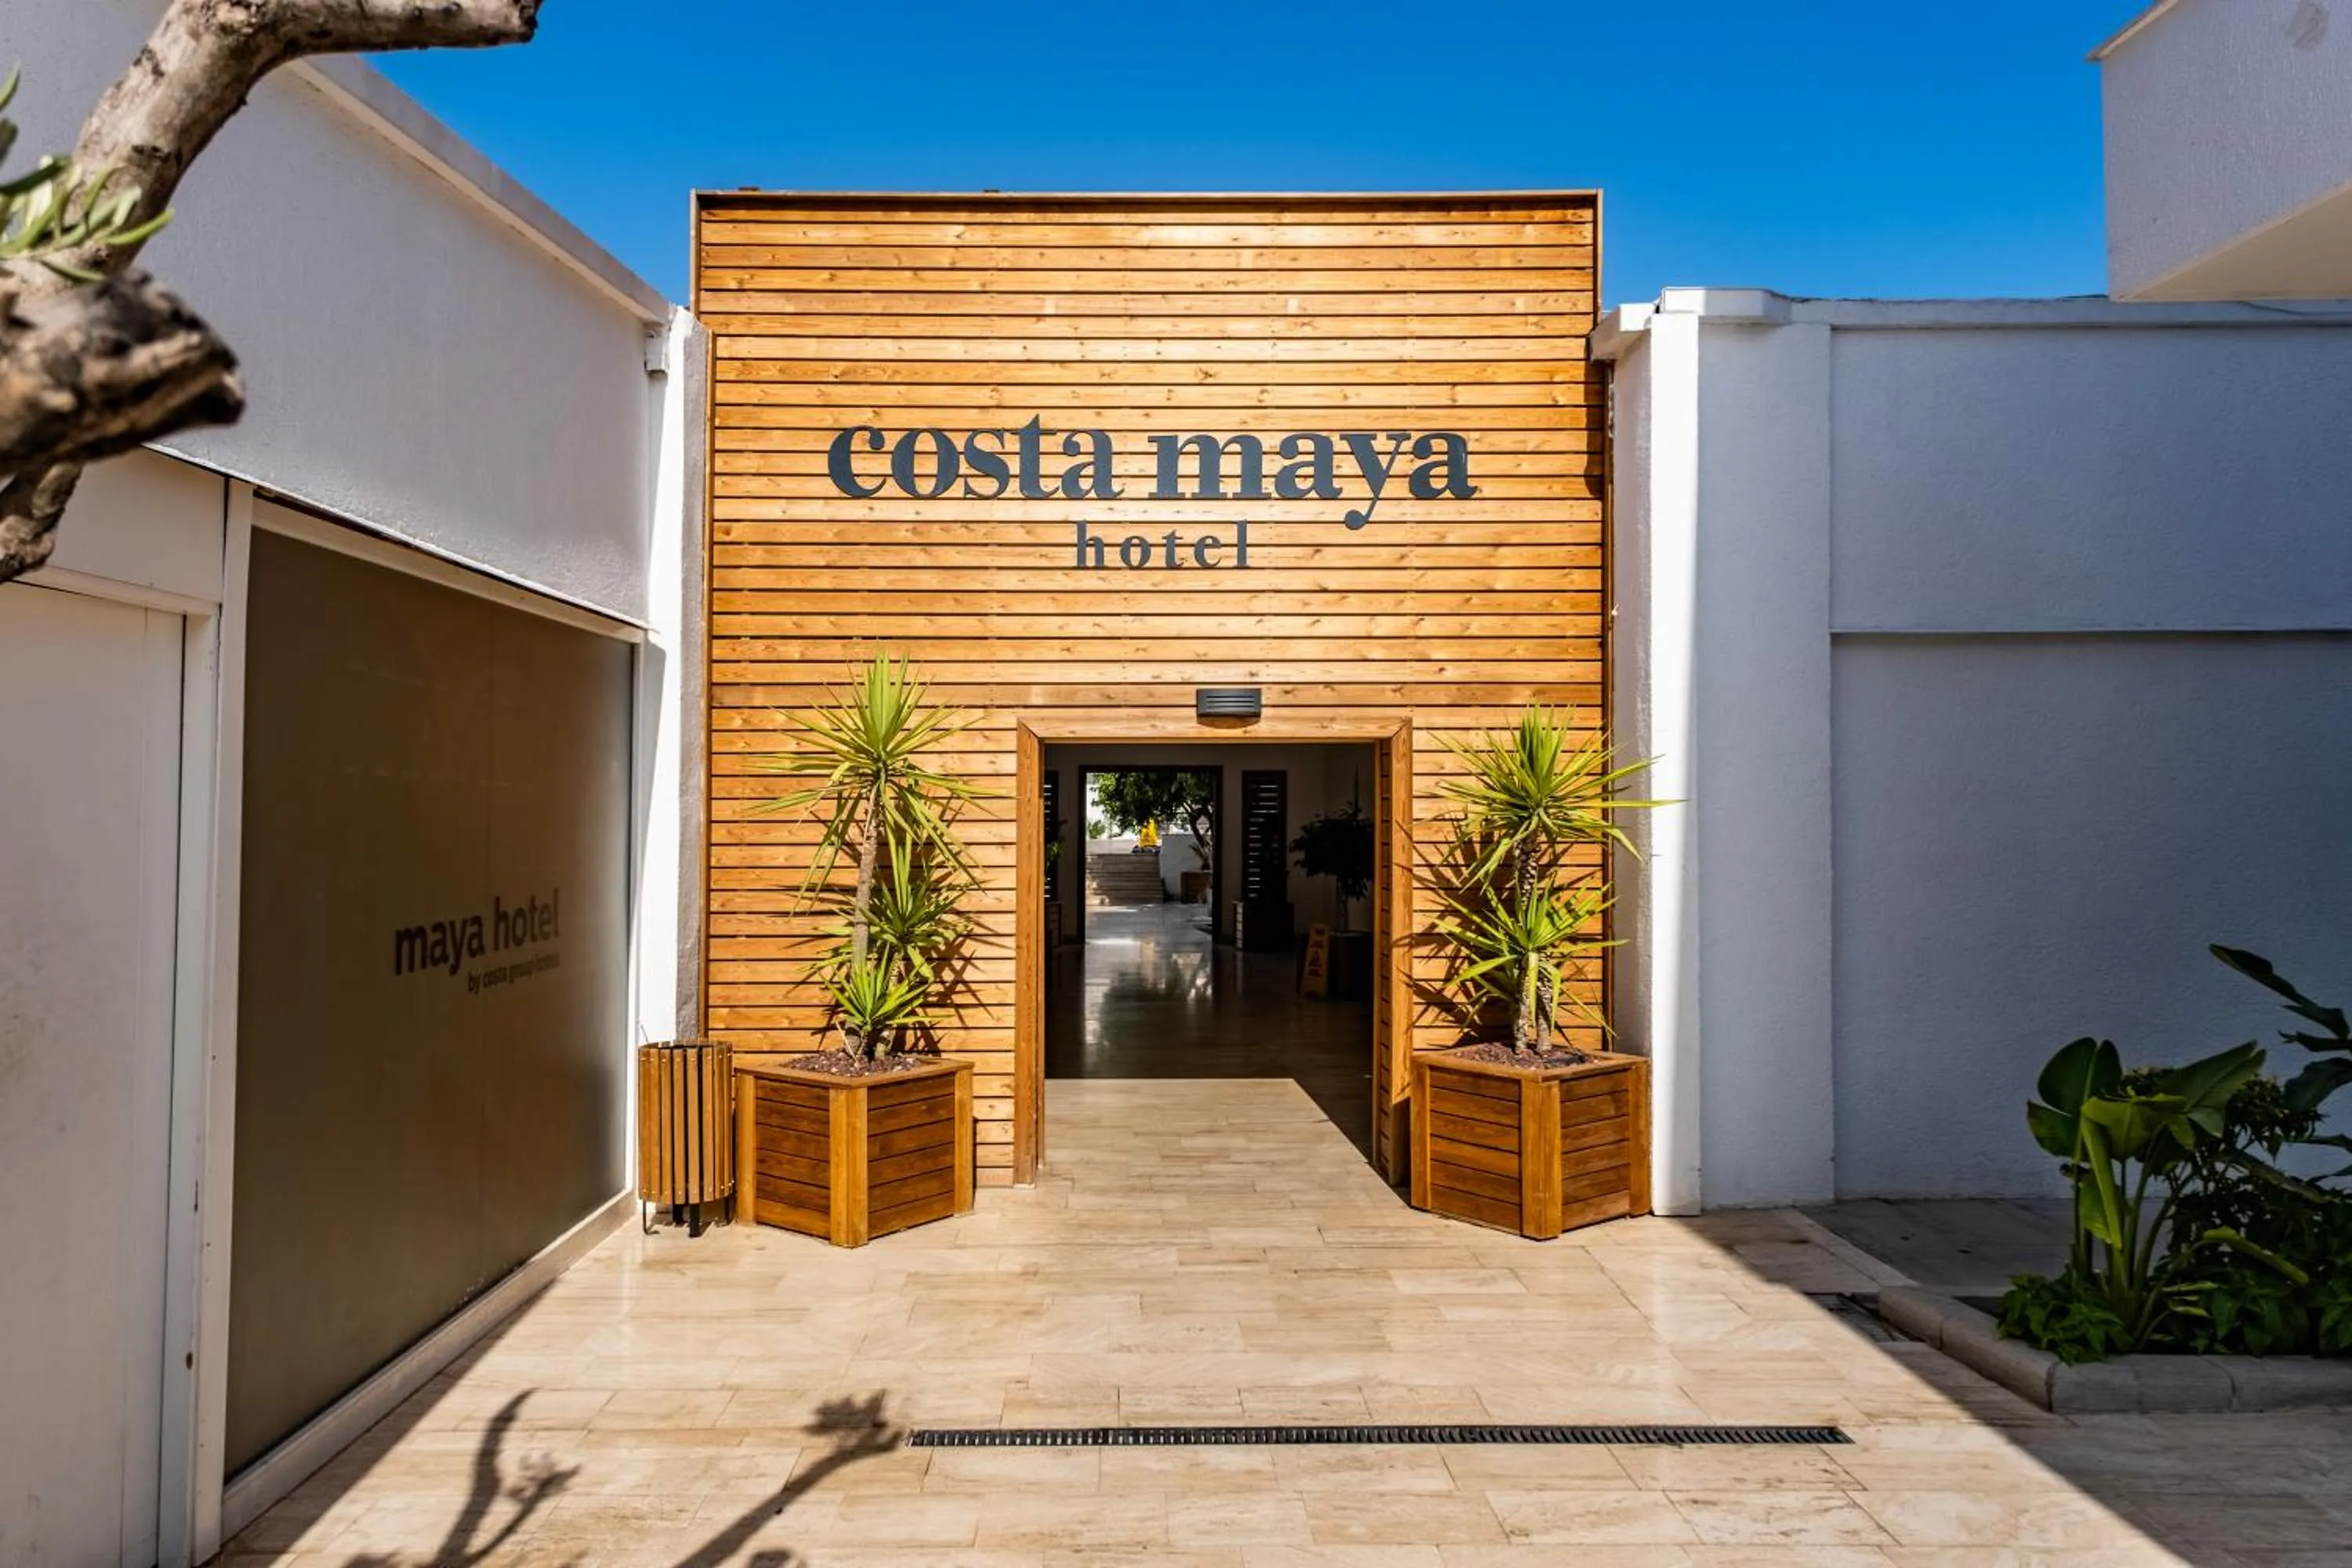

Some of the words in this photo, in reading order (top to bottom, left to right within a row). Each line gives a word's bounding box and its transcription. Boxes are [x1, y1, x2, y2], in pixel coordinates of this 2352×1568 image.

[828, 413, 1125, 499] costa
[1148, 432, 1479, 531] maya
[1075, 520, 1251, 570] hotel
[394, 915, 485, 976] maya
[493, 887, 560, 952] hotel
[468, 971, 481, 995] by
[483, 966, 507, 989] costa
